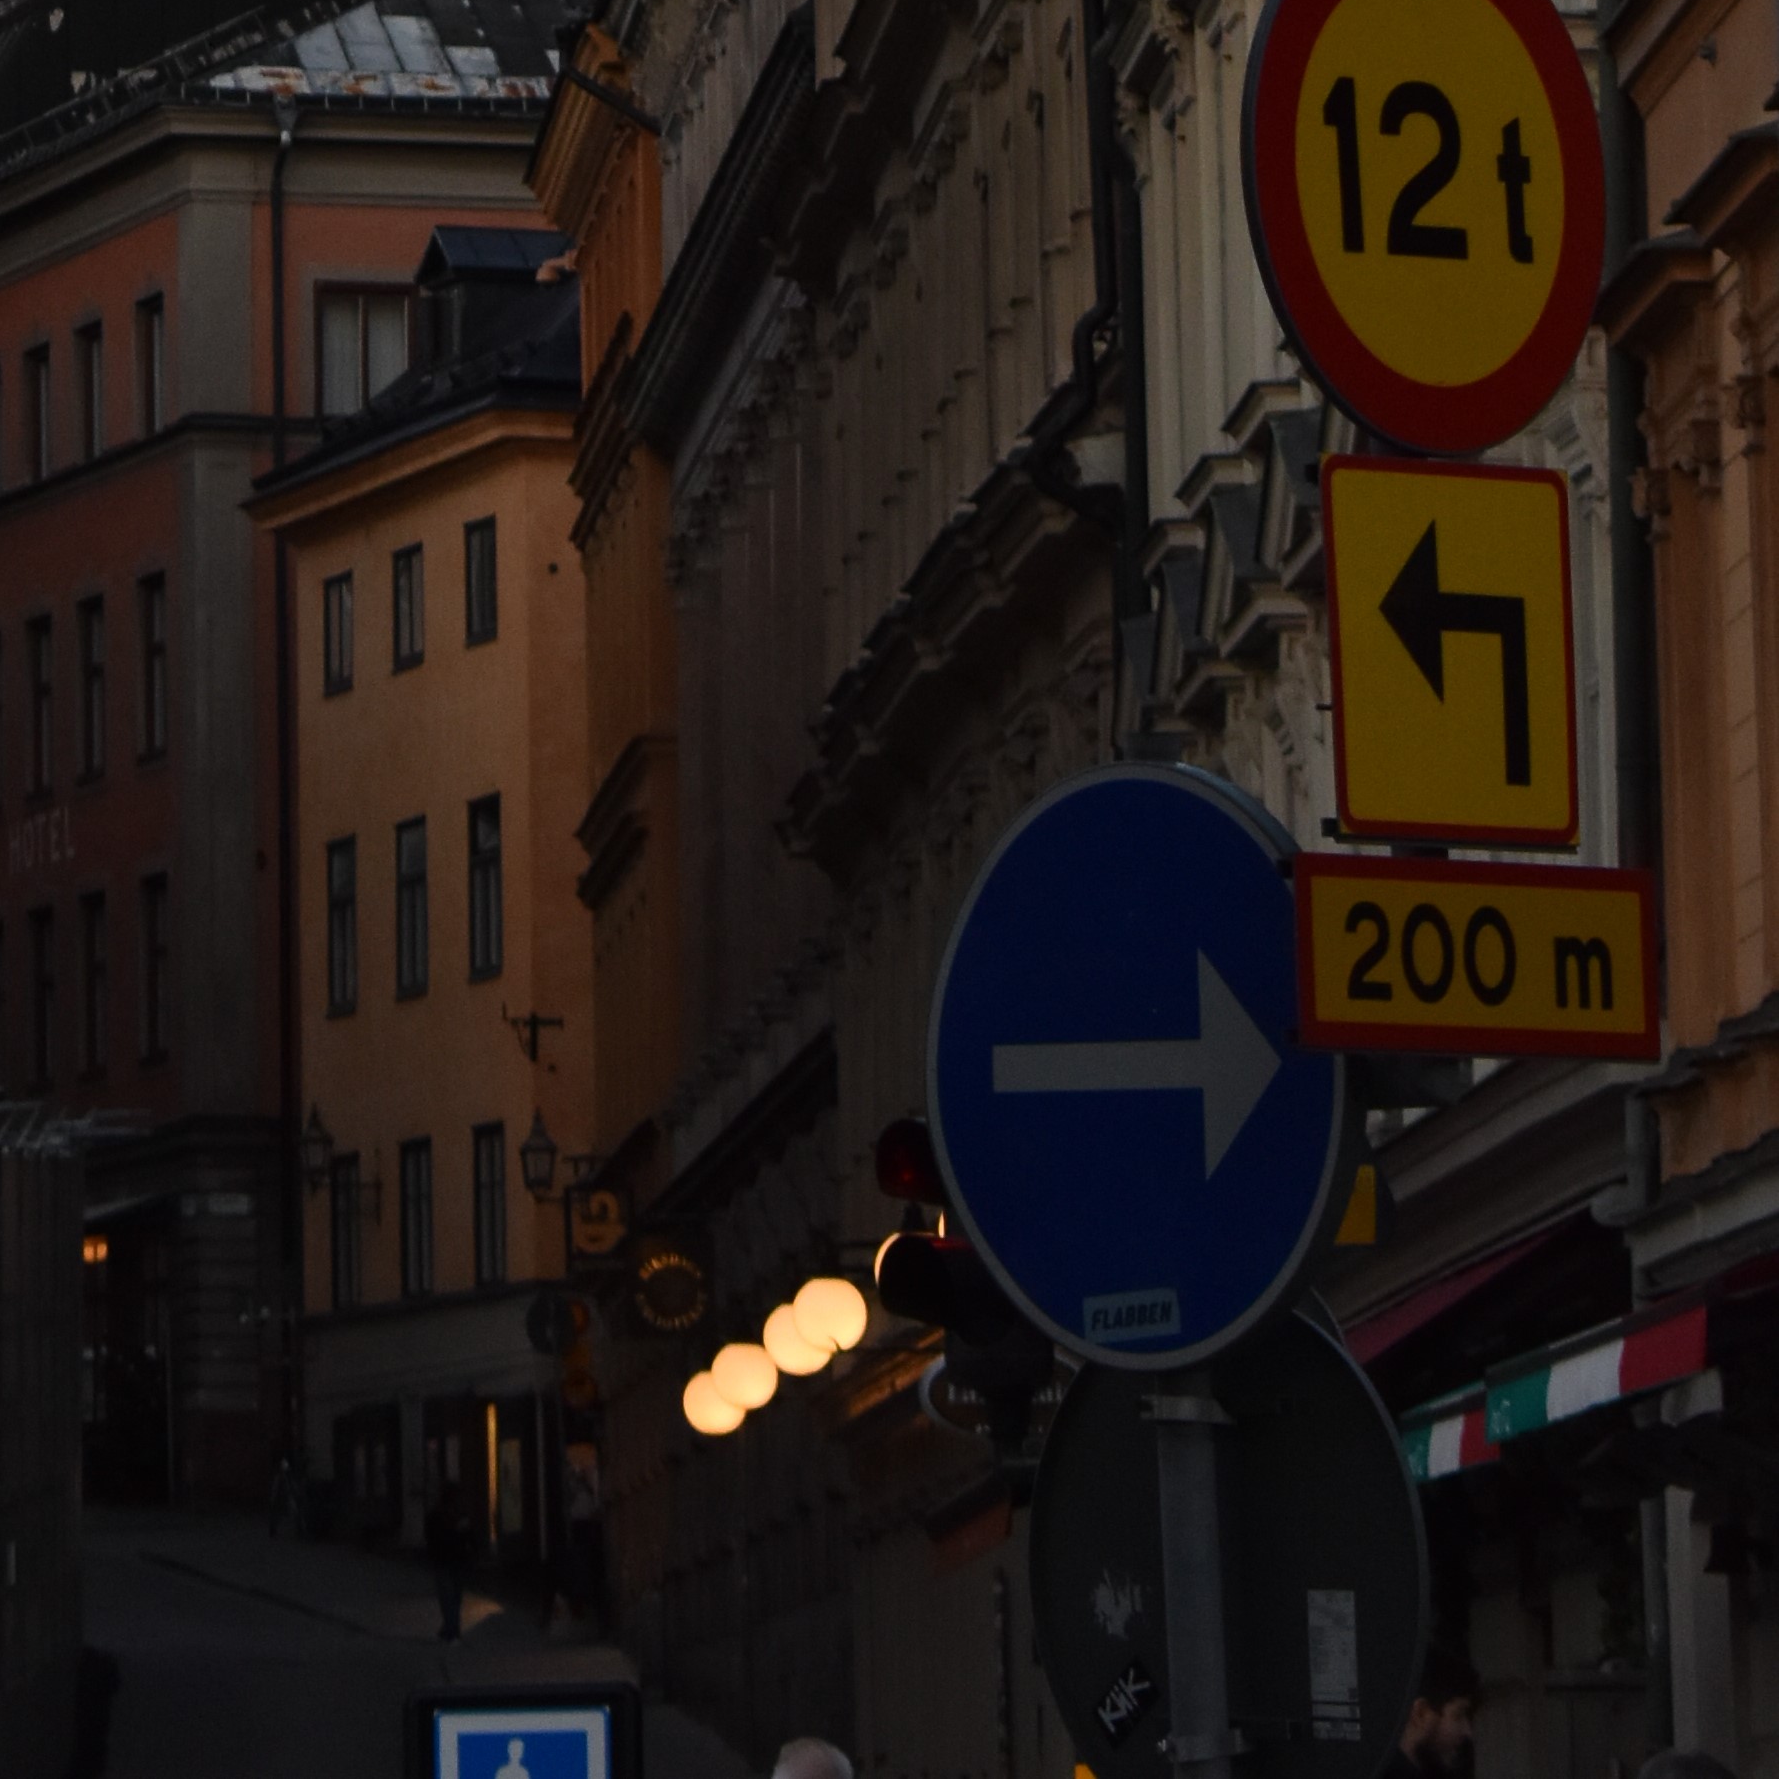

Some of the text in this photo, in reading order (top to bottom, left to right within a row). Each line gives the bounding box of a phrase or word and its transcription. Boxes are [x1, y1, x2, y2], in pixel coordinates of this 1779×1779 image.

[1322, 76, 1535, 265] 12 t
[1344, 901, 1614, 1010] 200 m
